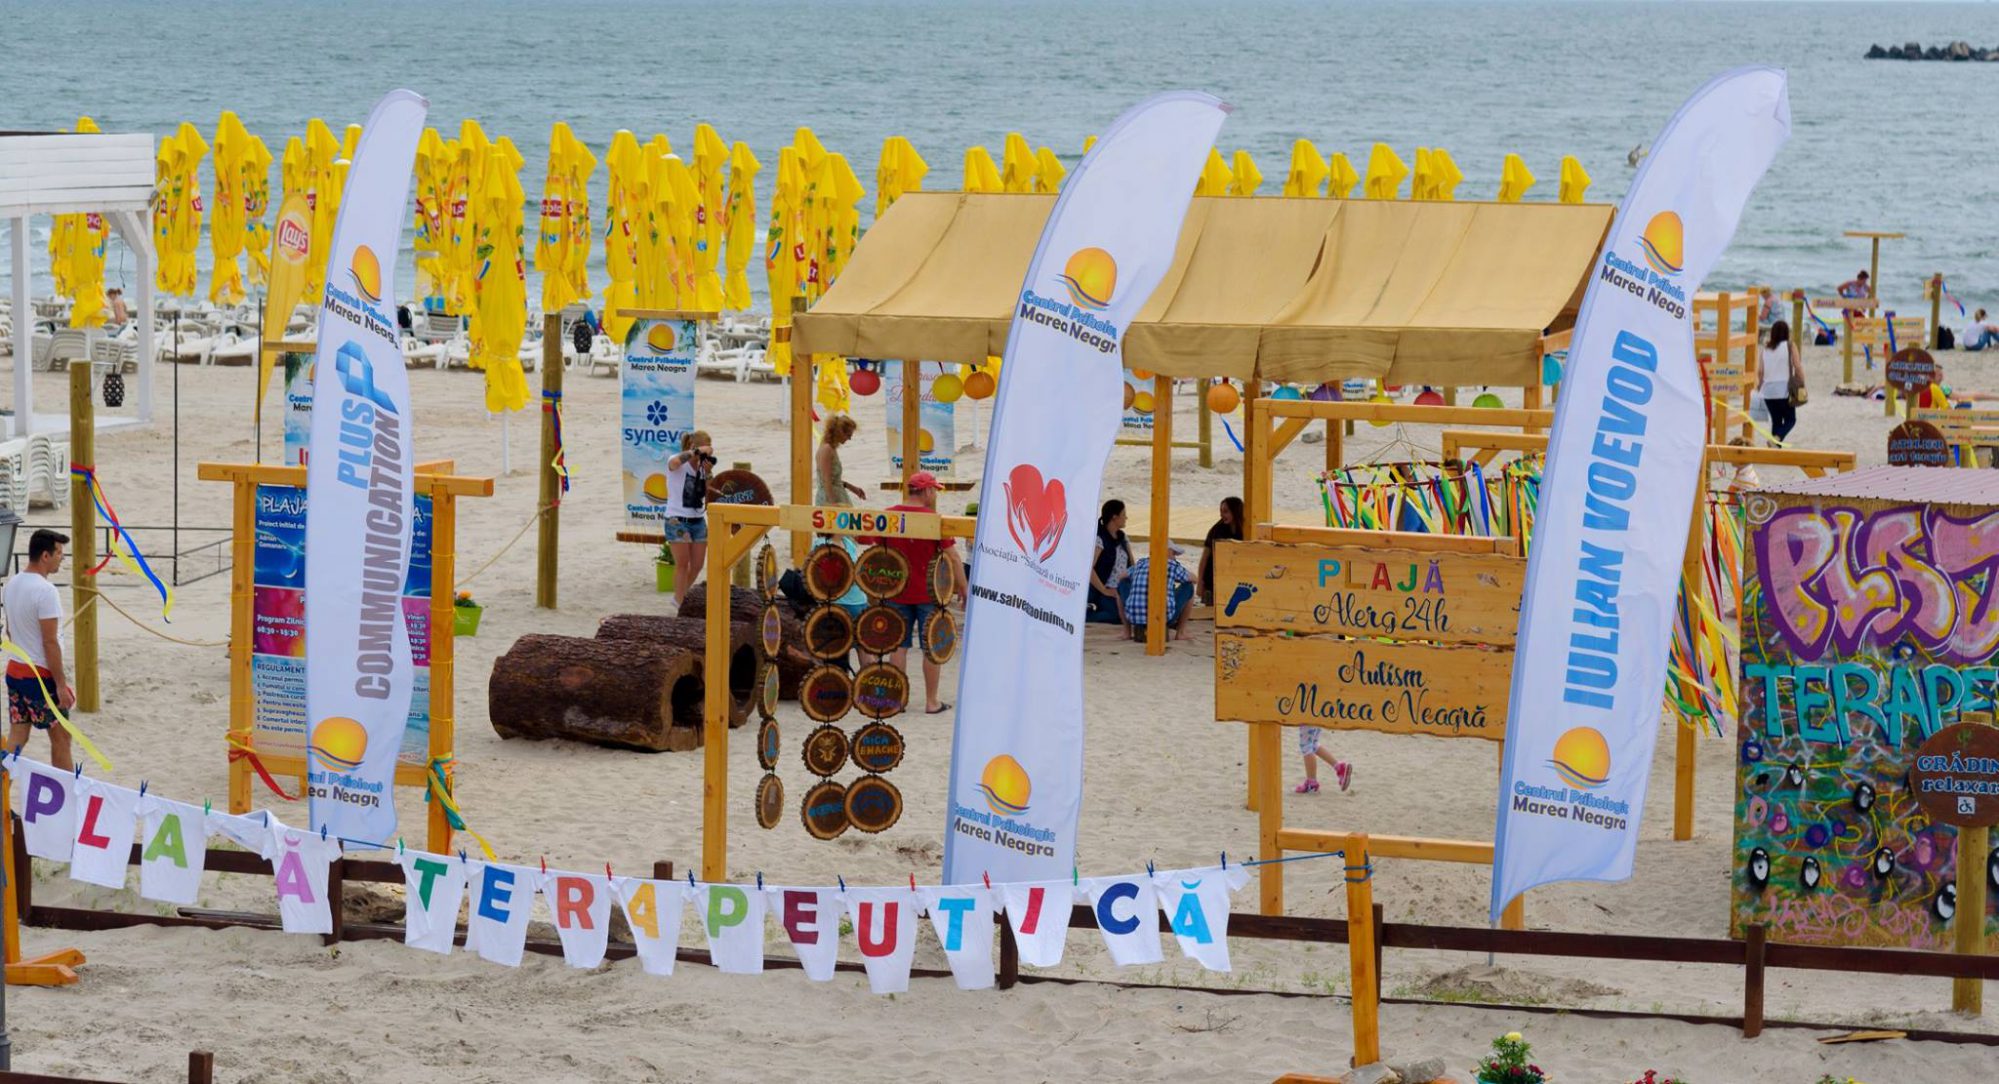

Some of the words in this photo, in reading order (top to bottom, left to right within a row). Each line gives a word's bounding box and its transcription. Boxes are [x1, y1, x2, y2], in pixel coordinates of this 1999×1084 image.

[1600, 264, 1645, 298] Marea
[324, 294, 362, 326] Marea
[1020, 303, 1068, 333] Marea
[631, 363, 655, 372] Marea
[656, 363, 687, 374] Neagra
[337, 397, 375, 490] PLUS
[1582, 329, 1658, 532] VOEVOD
[354, 407, 403, 701] COMMUNICATION
[1317, 558, 1446, 595] PLAJĂ
[1313, 591, 1398, 634] Alerg
[1401, 596, 1451, 634] 24h
[1563, 539, 1625, 711] IULIAN
[1337, 650, 1427, 689] Autism
[1277, 682, 1376, 721] Marea
[1380, 688, 1493, 734] Neagră
[1513, 780, 1568, 803] Centrul
[1512, 795, 1569, 819] Marea
[1571, 804, 1627, 830] Neagra
[994, 829, 1055, 858] Neagra
[412, 857, 1214, 958] TERAPEUTICĂ
